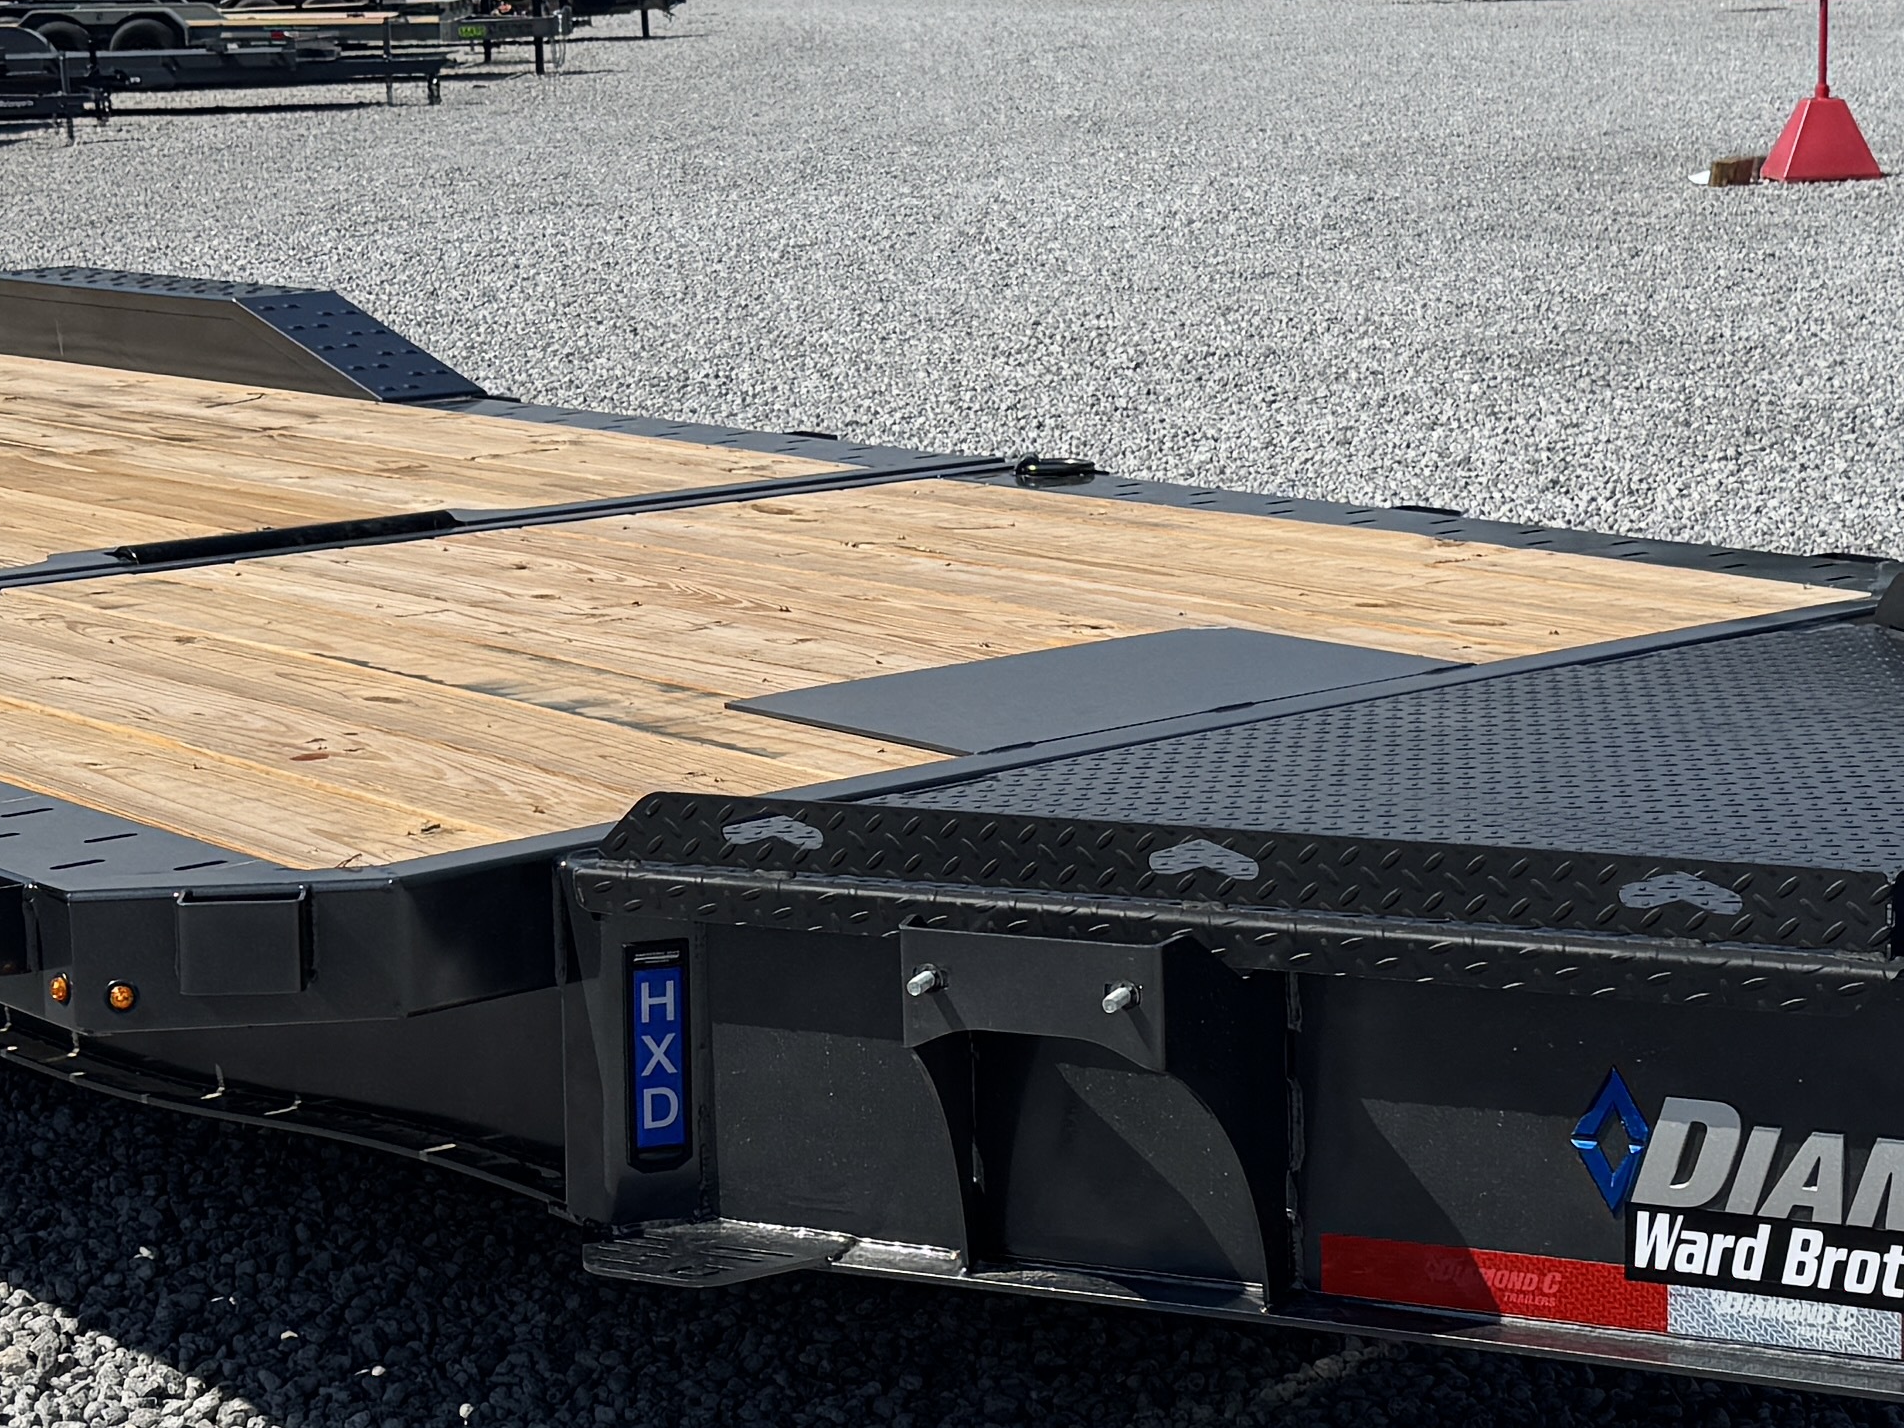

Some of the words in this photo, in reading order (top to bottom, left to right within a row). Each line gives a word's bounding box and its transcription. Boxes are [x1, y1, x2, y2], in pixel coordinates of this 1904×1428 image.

[641, 980, 679, 1130] HXD
[1634, 1210, 1772, 1281] Ward
[1504, 1292, 1556, 1307] TRAILERS
